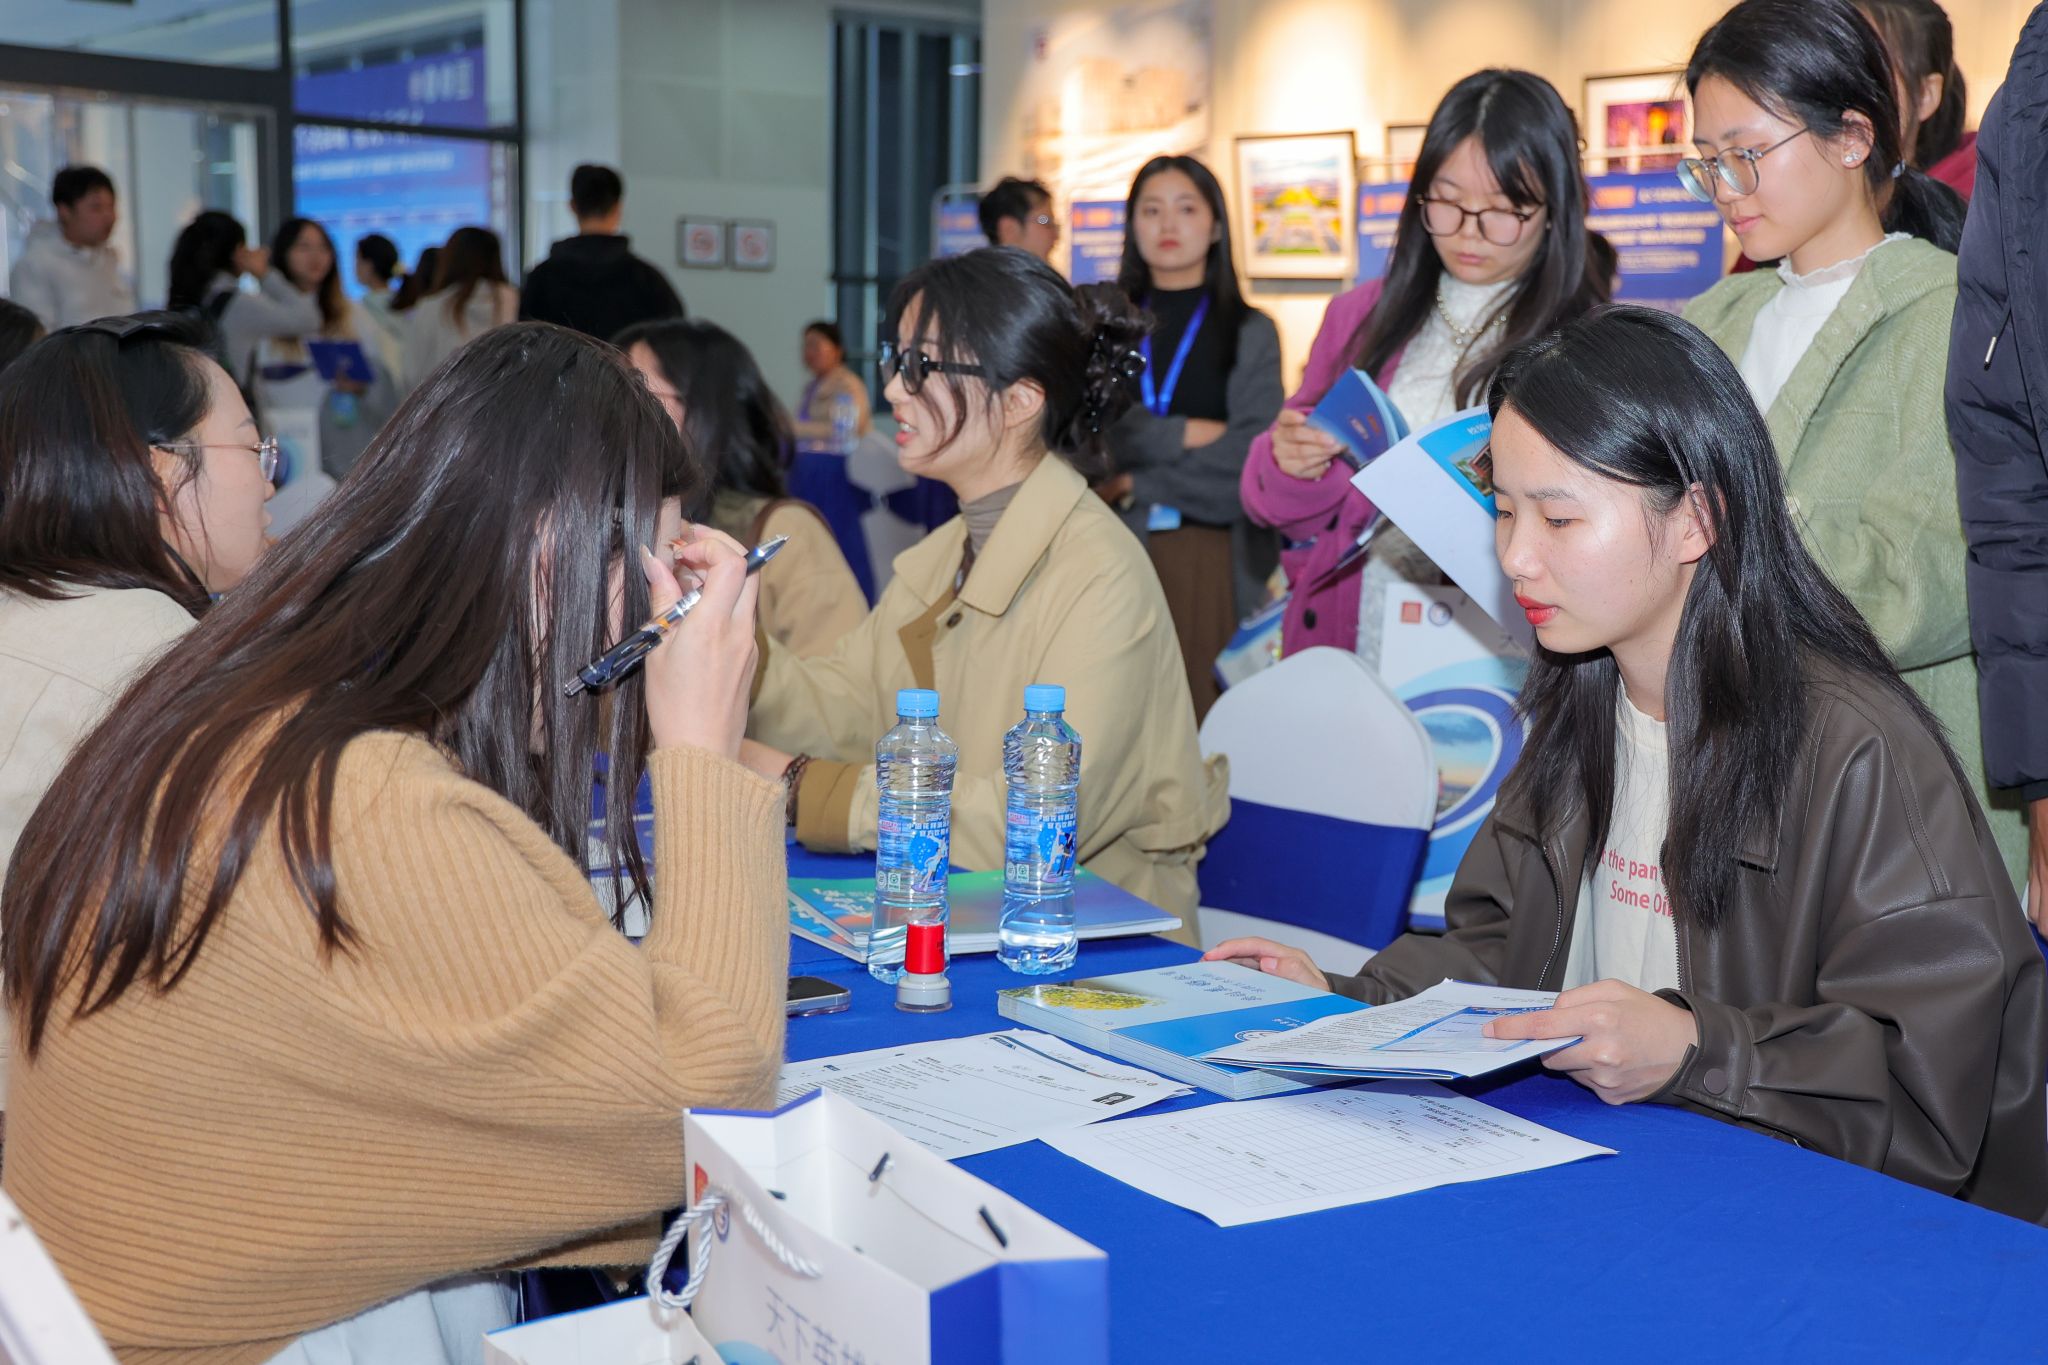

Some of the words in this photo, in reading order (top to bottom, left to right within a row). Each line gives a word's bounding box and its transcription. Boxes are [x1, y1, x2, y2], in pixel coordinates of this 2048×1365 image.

[1609, 848, 1625, 871] the
[1629, 860, 1657, 880] pan
[1610, 880, 1649, 908] Some
